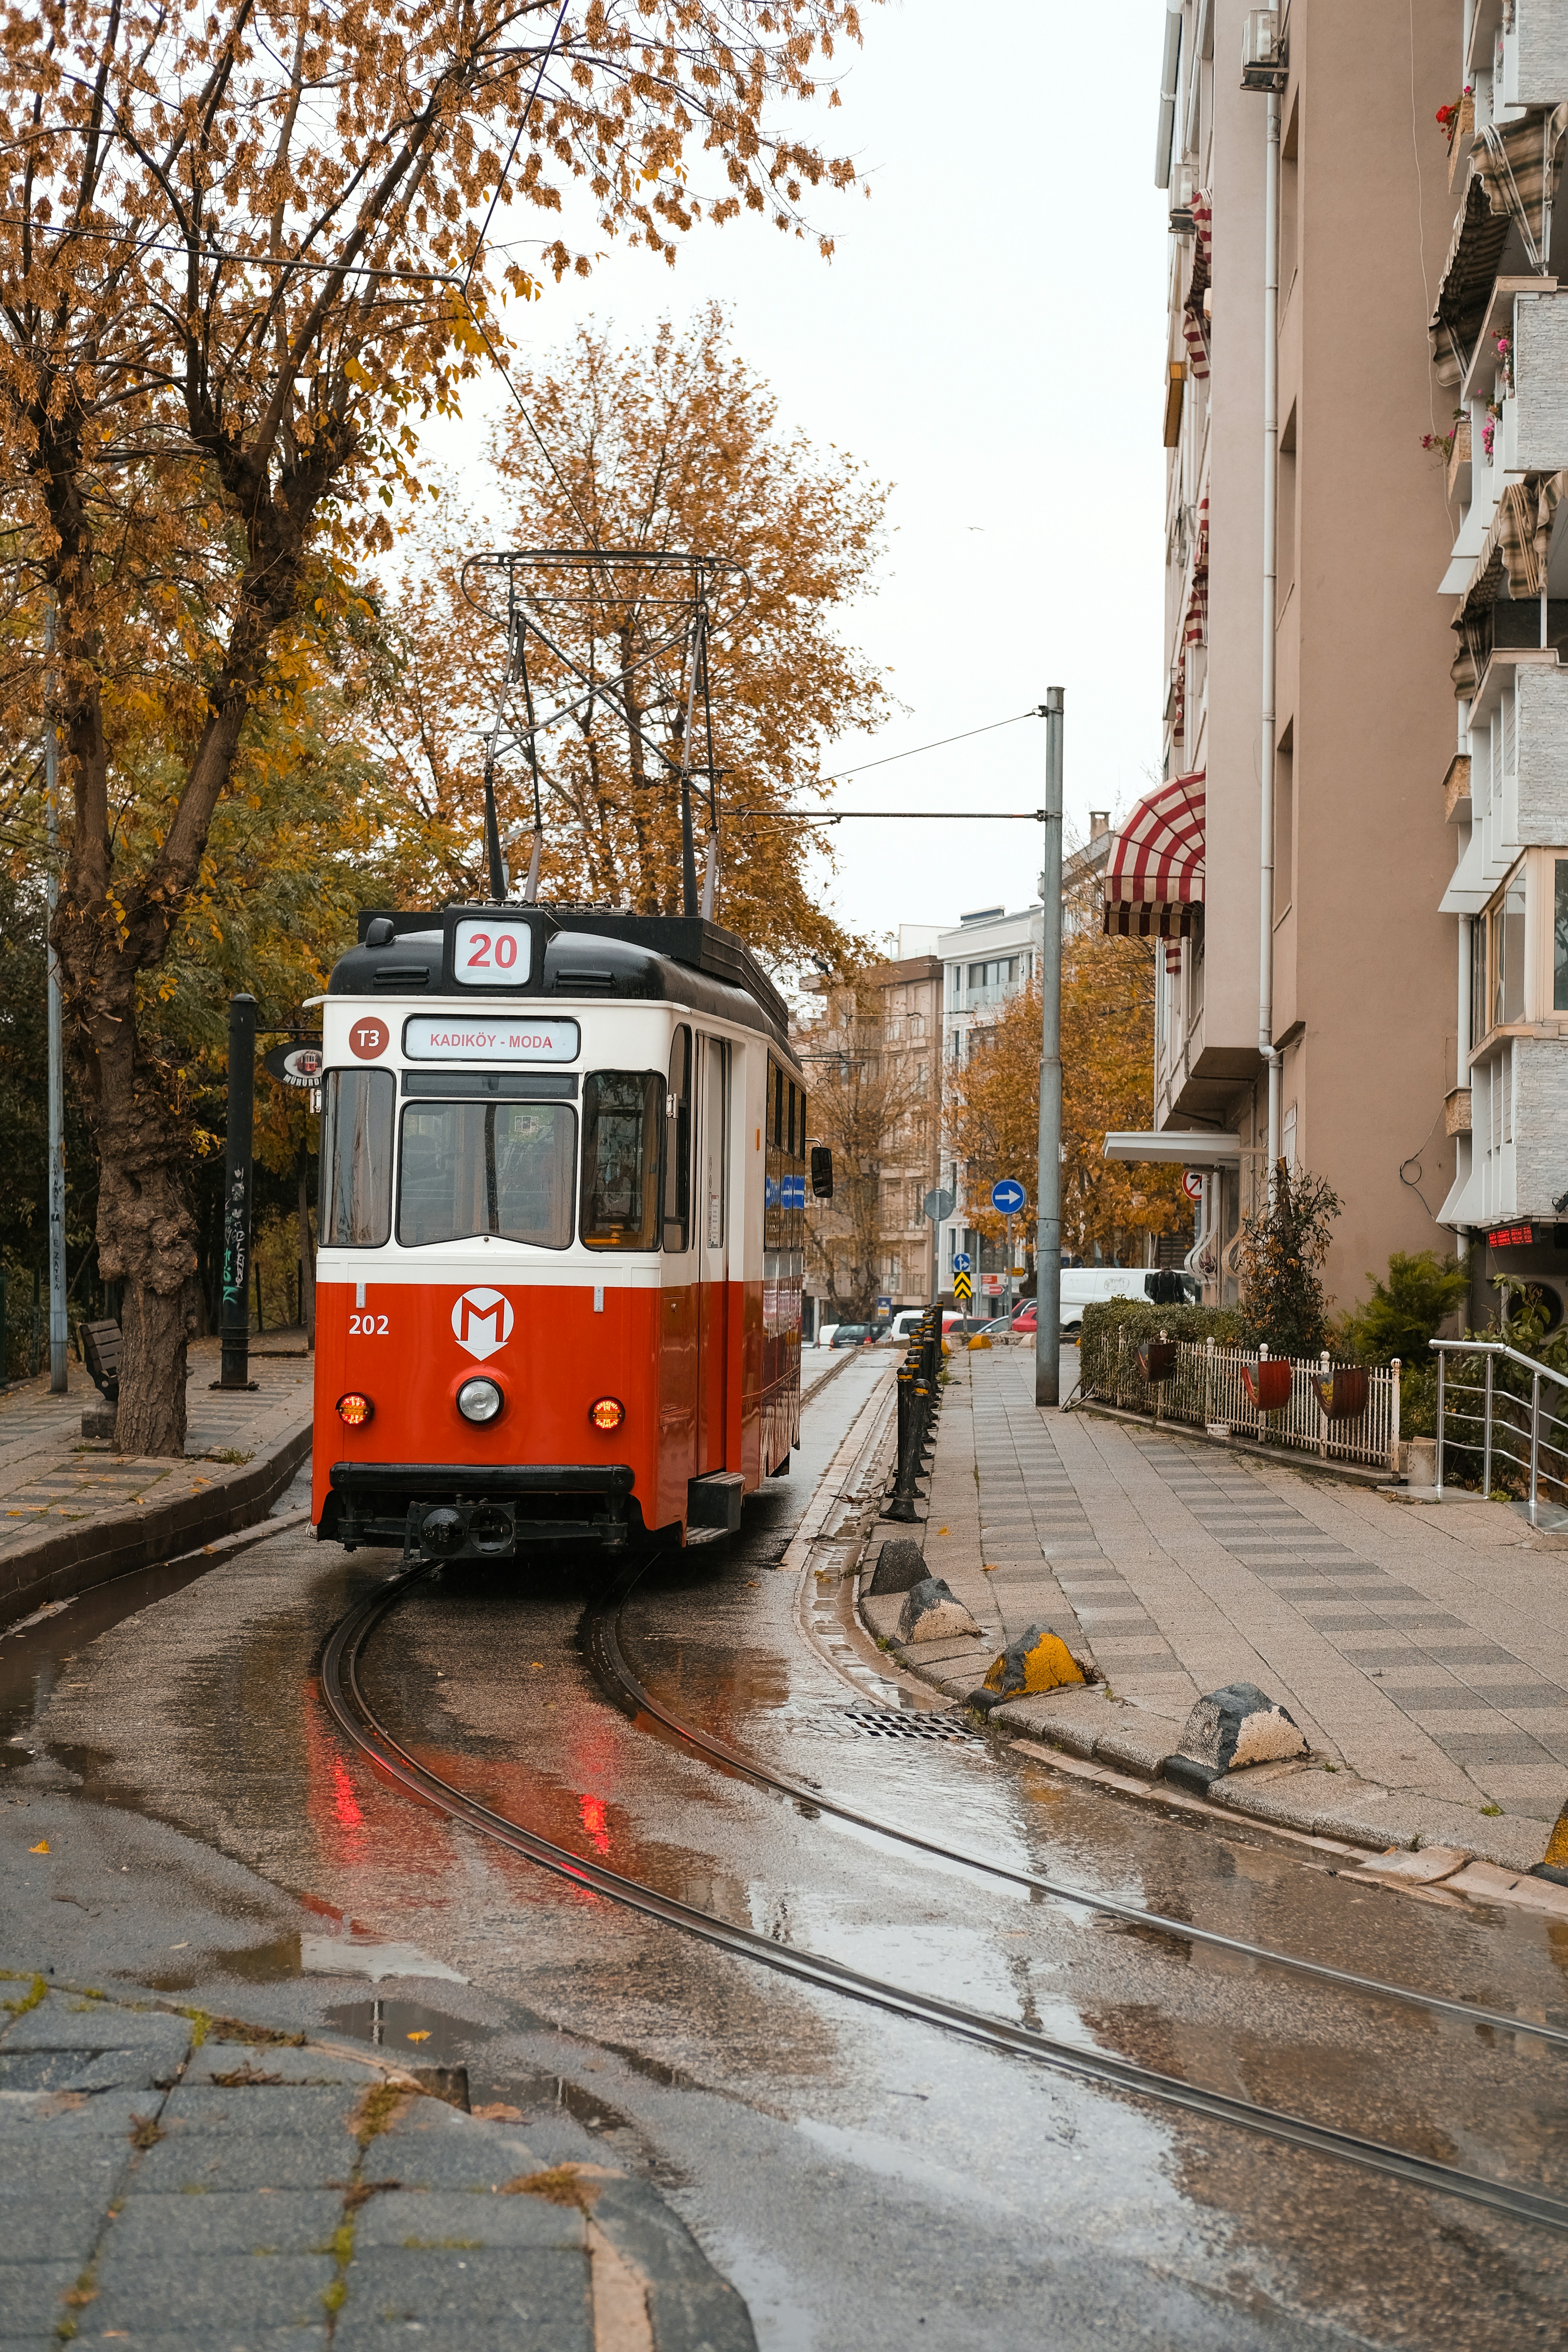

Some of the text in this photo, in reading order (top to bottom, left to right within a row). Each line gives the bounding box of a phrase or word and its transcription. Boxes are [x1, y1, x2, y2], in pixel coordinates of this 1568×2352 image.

[467, 934, 517, 968] 20
[357, 1029, 380, 1047] T3
[430, 1032, 496, 1047] KADIKÖY
[509, 1035, 553, 1048] MODA
[349, 1315, 389, 1335] 202
[460, 1295, 505, 1343] M
